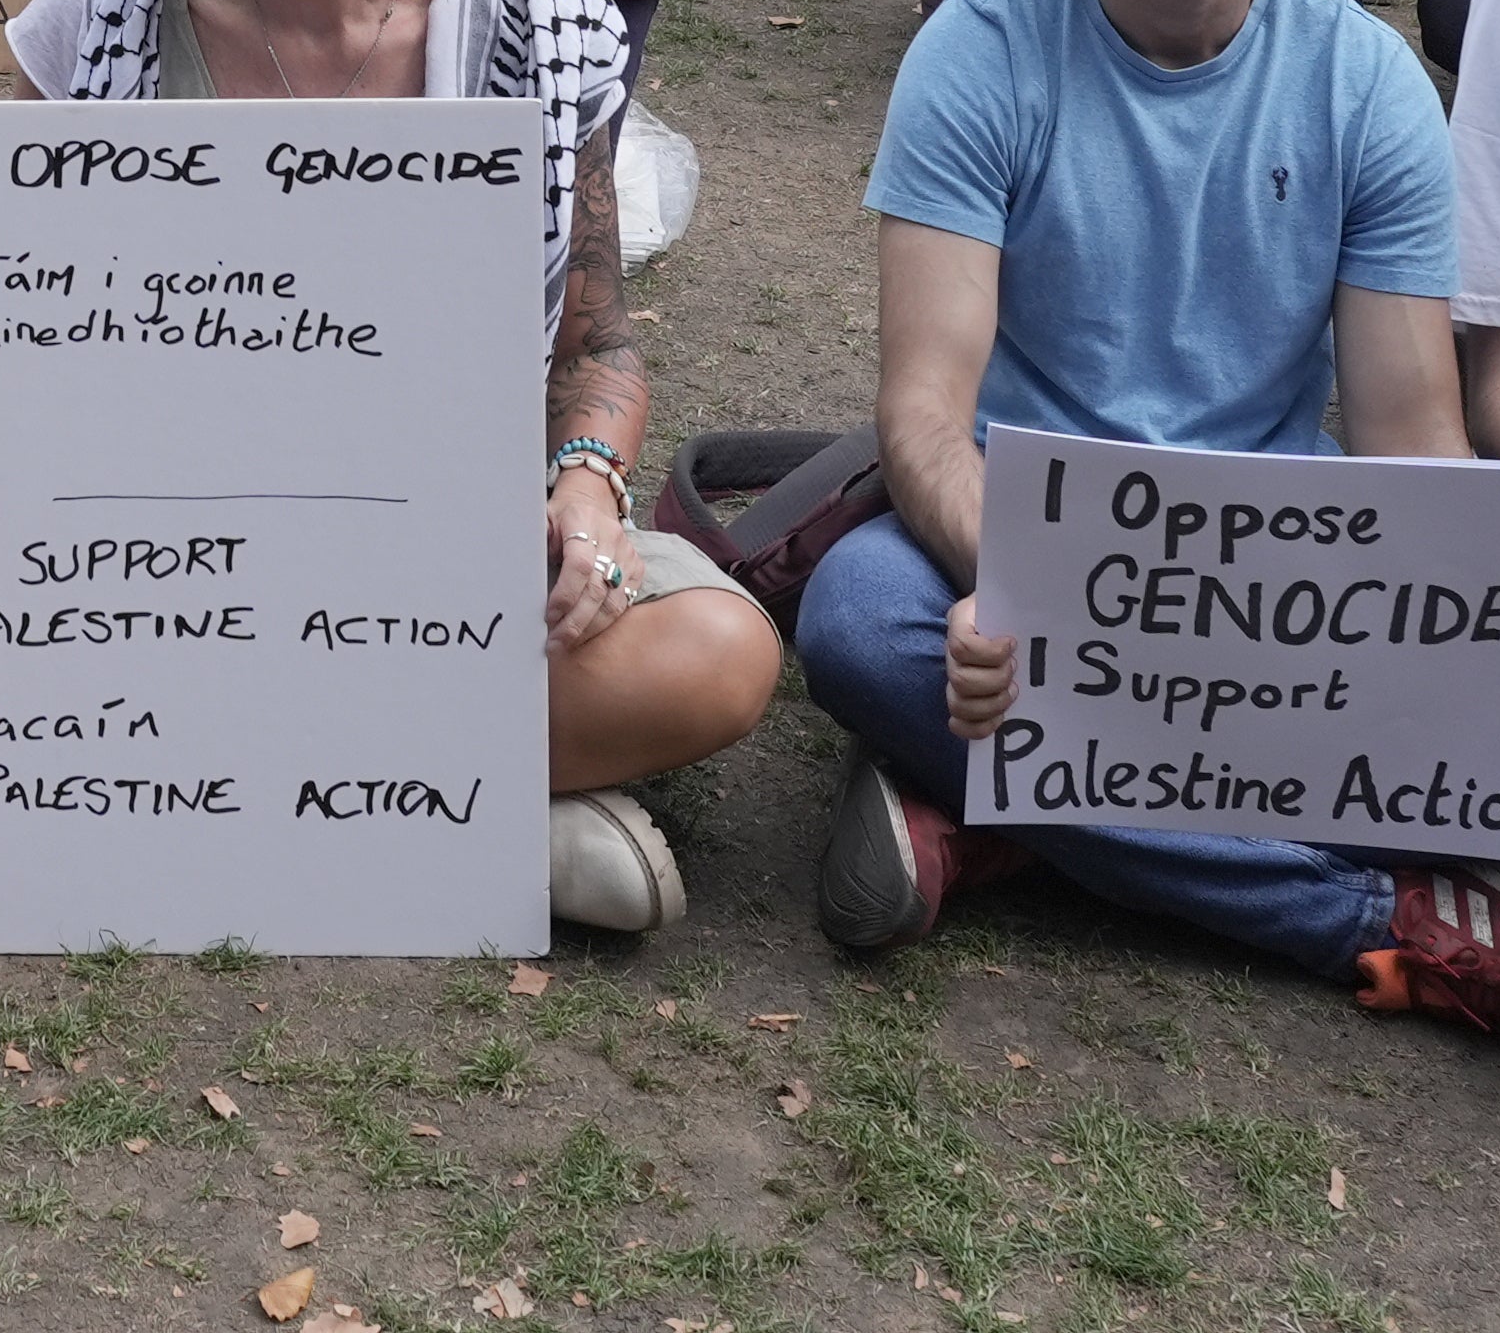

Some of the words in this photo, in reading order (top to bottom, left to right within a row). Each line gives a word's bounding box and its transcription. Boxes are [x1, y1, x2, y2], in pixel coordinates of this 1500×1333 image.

[10, 141, 221, 188] OPPOSE
[266, 142, 525, 195] GENOCIDE
[1043, 458, 1066, 525] I
[1110, 468, 1383, 566] Oppose
[19, 534, 248, 586] SUPPORT
[300, 609, 504, 652] ACTION
[1029, 636, 1046, 688] I
[1072, 642, 1351, 732] Support
[991, 716, 1305, 819] Palestine
[296, 776, 483, 825] ACTION
